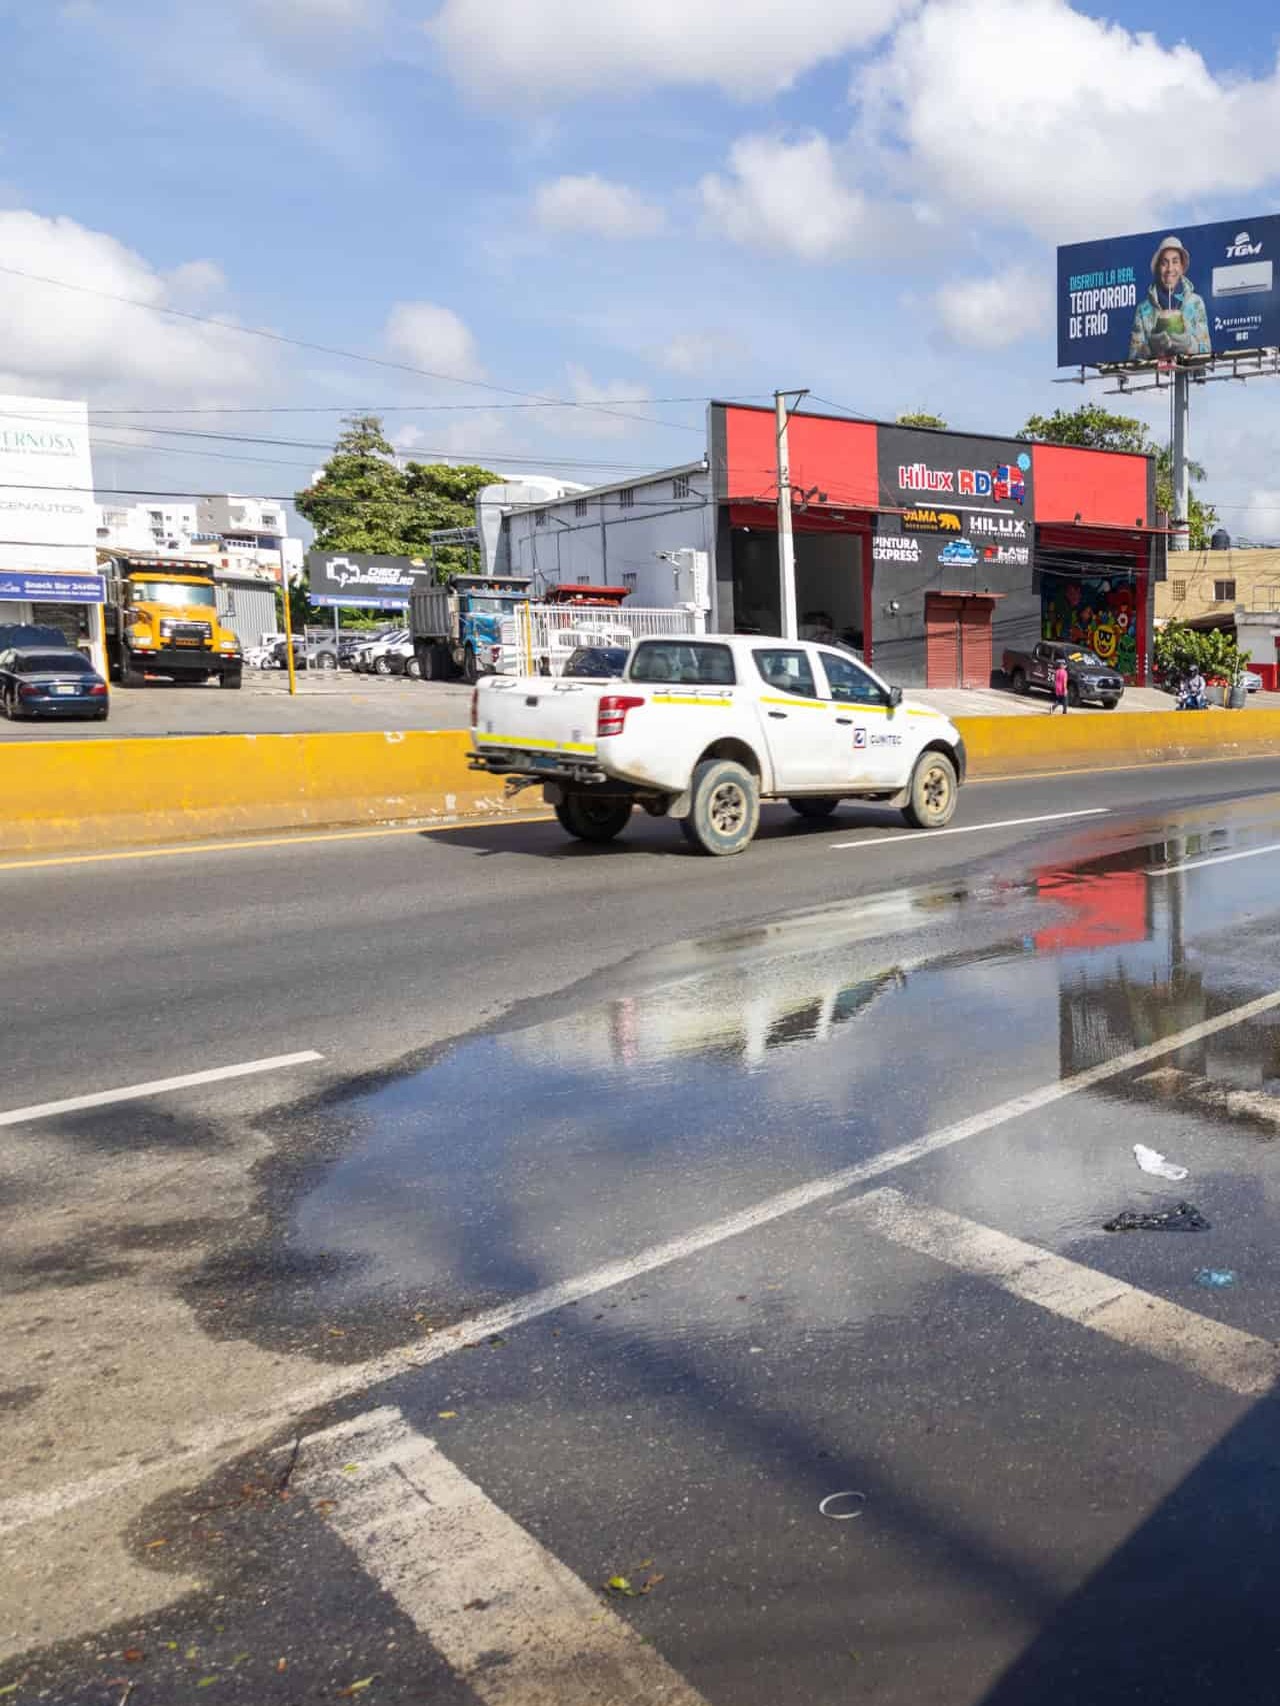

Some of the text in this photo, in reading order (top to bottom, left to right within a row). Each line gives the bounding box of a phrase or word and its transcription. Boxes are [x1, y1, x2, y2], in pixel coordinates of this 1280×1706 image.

[1225, 241, 1262, 258] TGM
[1070, 266, 1136, 291] DISFRUTA LA REAL
[1070, 284, 1136, 314] TEMPORADA
[1069, 309, 1108, 338] DE FRÍO
[0, 430, 76, 450] ERNOSA
[899, 464, 991, 495] Hilux RD
[904, 510, 937, 522] JAMA
[872, 536, 919, 549] PINTURA
[872, 548, 919, 562] EXPRESS
[368, 567, 403, 576] CHECK
